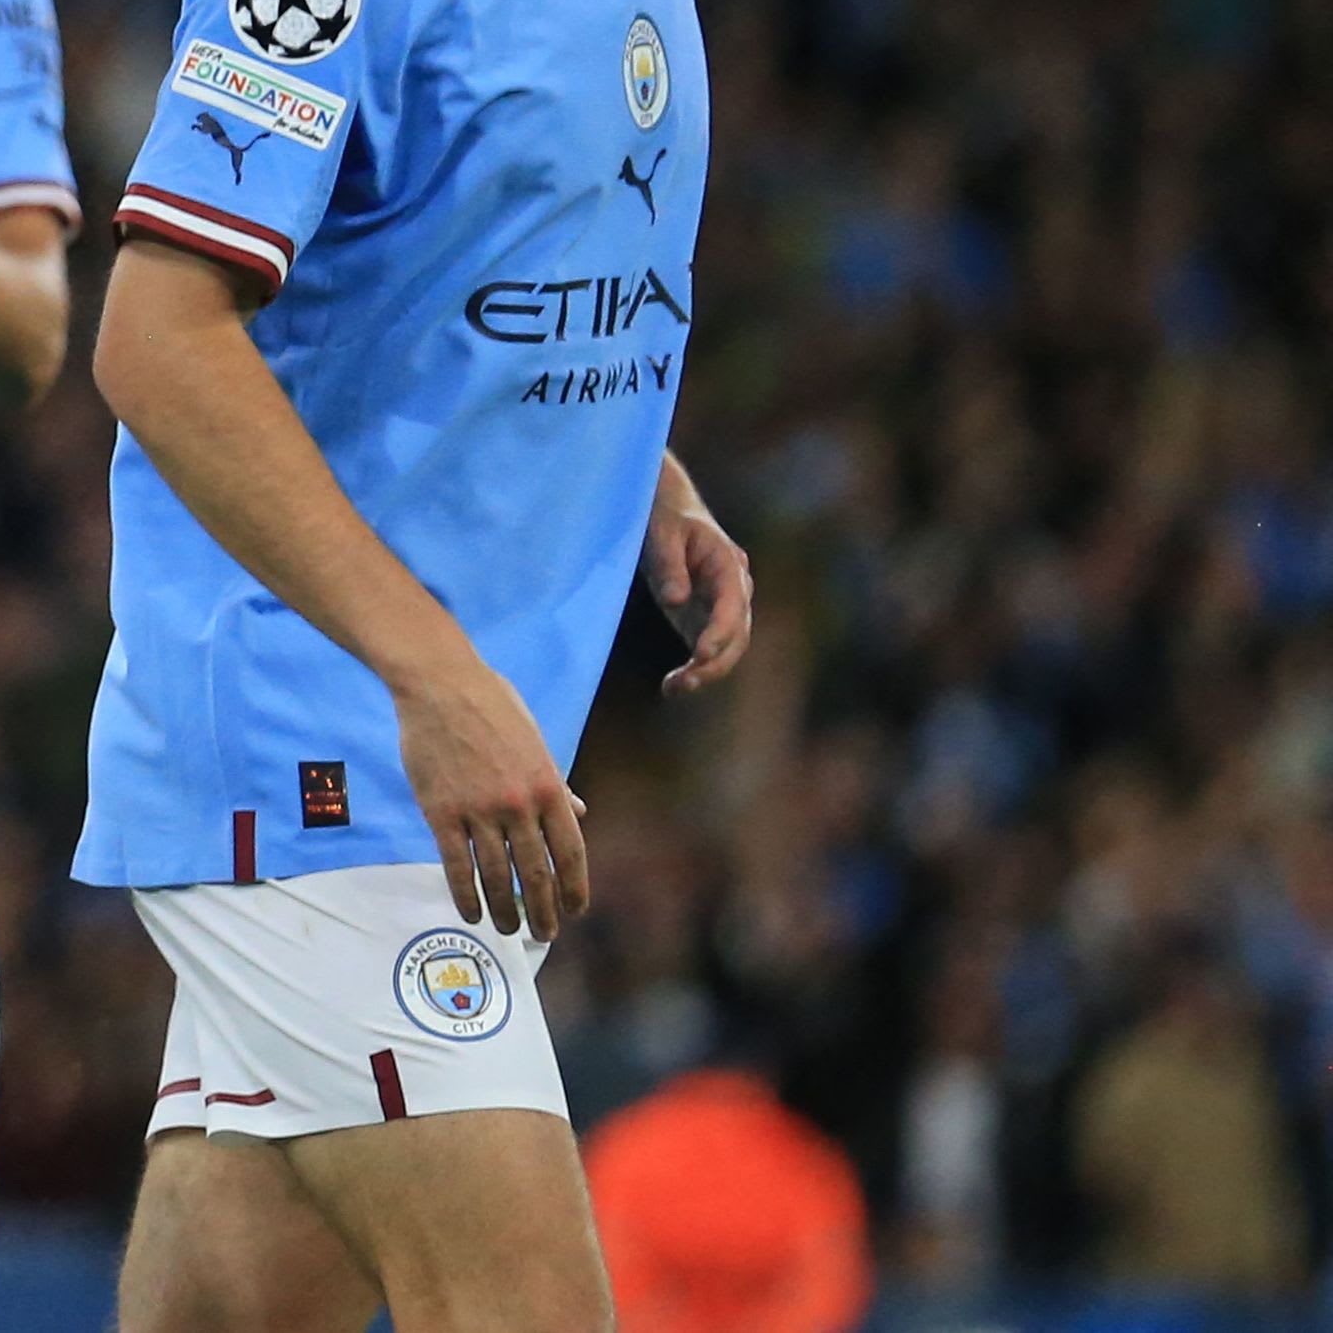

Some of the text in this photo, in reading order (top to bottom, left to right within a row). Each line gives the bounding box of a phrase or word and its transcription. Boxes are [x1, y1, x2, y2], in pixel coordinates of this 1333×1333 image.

[192, 44, 223, 63] UEFA
[183, 56, 334, 131] FOUNDATION
[405, 937, 493, 977] MANCHESTER
[452, 1021, 485, 1034] CITY
